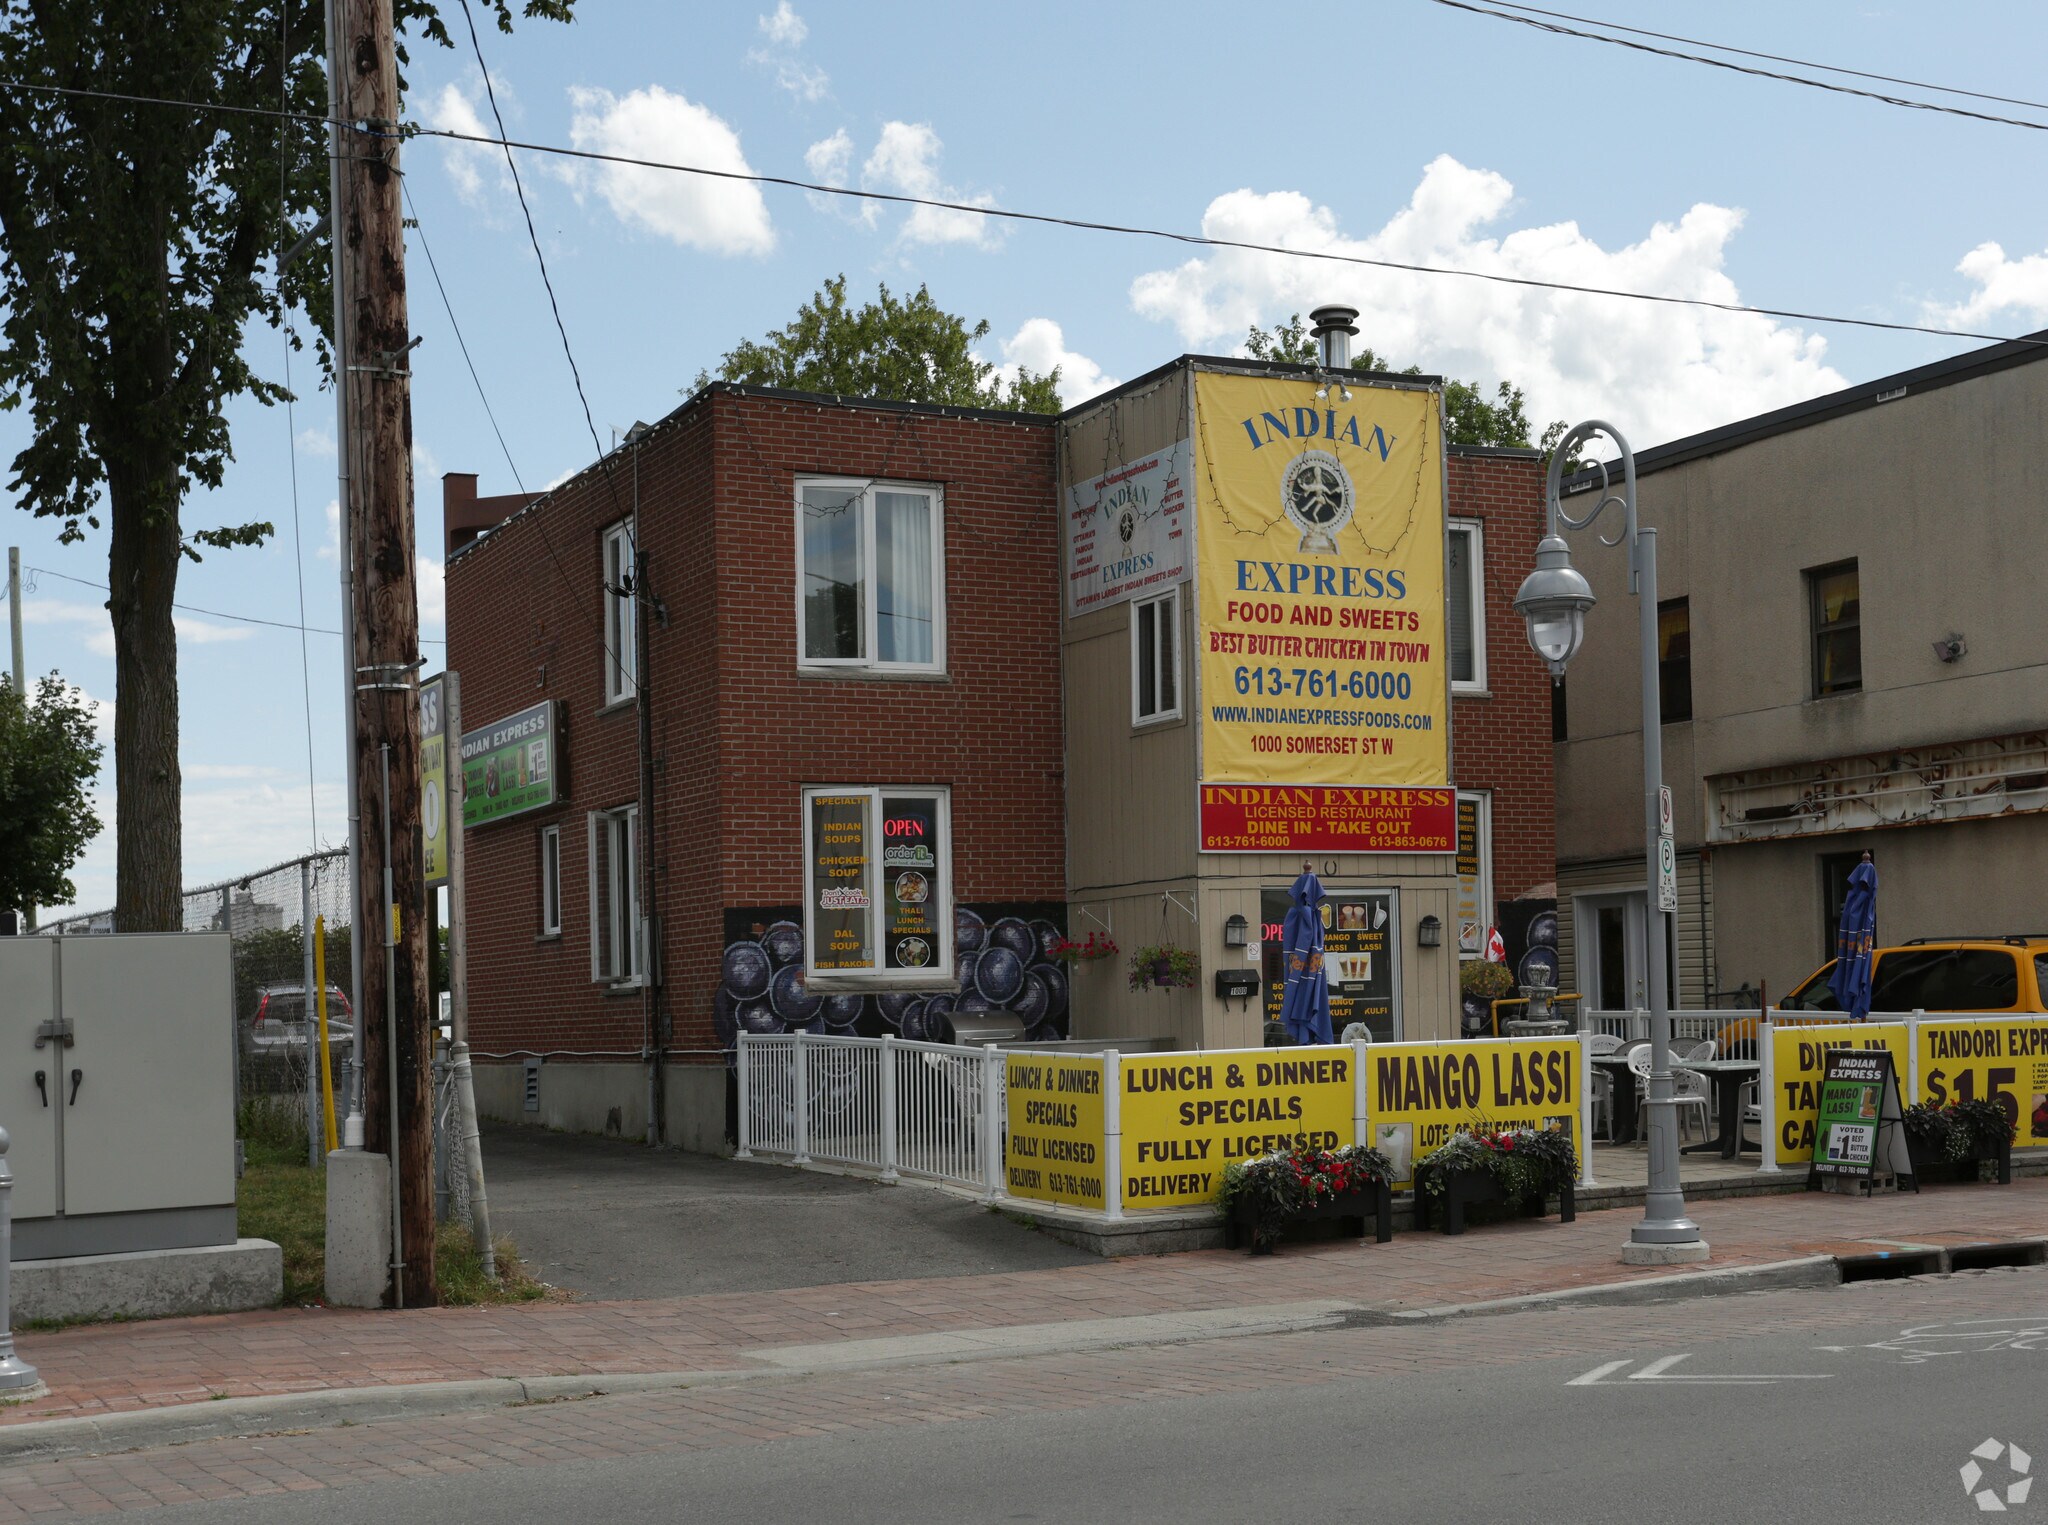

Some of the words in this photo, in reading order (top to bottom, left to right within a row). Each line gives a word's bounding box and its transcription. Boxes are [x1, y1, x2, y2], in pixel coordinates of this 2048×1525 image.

[1240, 407, 1397, 463] INDIAN
[1167, 478, 1180, 489] BEST
[1104, 485, 1150, 521] INDIAN
[1164, 490, 1184, 504] BUTTER
[1163, 502, 1185, 517] CHICKEN
[1171, 518, 1178, 527] IN
[1168, 529, 1183, 541] TOWN
[1075, 542, 1094, 555] FAMOUS
[1077, 555, 1093, 567] INDIAN
[1103, 551, 1154, 584] EXPRESS
[1070, 564, 1100, 581] RESTAURANT
[1234, 559, 1407, 600] EXPRESS
[1101, 584, 1124, 599] LARGEST
[1124, 578, 1143, 592] INDIAN
[1167, 565, 1183, 578] SHOP
[1227, 601, 1283, 624] FOOD
[1290, 605, 1333, 627] AND
[1339, 608, 1419, 632] SWEETS
[1210, 631, 1244, 653] BEST
[1248, 633, 1302, 657] BUTTER
[1305, 637, 1366, 661] CHICKEN
[1370, 640, 1386, 662] IN
[1389, 641, 1430, 663] TOWN
[1234, 666, 1411, 700] 613-761-6000
[1212, 706, 1432, 730] WWW.INDIANEXPRESSFOODS.COM
[494, 714, 545, 747] EXPRESS
[1250, 735, 1282, 753] 1000
[1286, 736, 1358, 754] SOMERSET
[1362, 738, 1378, 755] ST
[1382, 738, 1393, 755] W
[815, 798, 869, 806] SPECIALTY
[1204, 788, 1315, 805] INDIAN
[1323, 789, 1449, 807] EXPRESS
[1245, 806, 1316, 818] LICENSED
[1320, 807, 1412, 820] RESTAURANT
[824, 823, 861, 831] INDIAN
[884, 819, 924, 836] OPEN
[1247, 821, 1290, 834] DINE
[1294, 821, 1312, 834] IN
[1327, 822, 1371, 834] TAKE
[1376, 822, 1411, 834] OUT
[1458, 824, 1475, 832] SWEETS
[824, 835, 861, 843] SOUPS
[1207, 836, 1290, 846] 613-761-6000
[1369, 836, 1447, 847] 613-863-0676
[887, 847, 915, 859] order
[917, 847, 925, 859] it
[819, 856, 869, 865] CHICKEN
[829, 869, 859, 877] SOUP
[900, 907, 924, 915] THALI
[834, 930, 855, 938] DAL
[1260, 923, 1284, 941] OPE
[830, 942, 859, 950] SOUP
[1232, 987, 1247, 995] 1000
[1927, 1029, 2002, 1059] TANDORI
[1838, 1058, 1877, 1068] INDIAN
[1009, 1065, 1041, 1090] LUNCH
[1045, 1068, 1054, 1091] &
[1058, 1069, 1099, 1095] DINNER
[1127, 1066, 1213, 1093] LUNCH
[1225, 1063, 1244, 1088] &
[1256, 1059, 1347, 1087] DINNER
[1377, 1053, 1481, 1112] MANGO
[1492, 1050, 1571, 1107] LASSI
[1830, 1070, 1882, 1079] EXPRESS
[1826, 1088, 1858, 1100] MANGO
[1026, 1100, 1078, 1128] SPECIALS
[1179, 1095, 1302, 1126] SPECIALS
[1826, 1102, 1853, 1114] LASSI
[1420, 1123, 1449, 1147] LOTS
[1012, 1135, 1039, 1158] FULLY
[1043, 1138, 1095, 1164] LICENSED
[1138, 1138, 1212, 1163] FULLY
[1223, 1130, 1339, 1158] LICENSED
[1850, 1144, 1868, 1152] BUTTER
[1850, 1153, 1869, 1161] CHICKEN
[1815, 1163, 1835, 1172] DELIVERY
[1839, 1165, 1869, 1175] 613-761-6000
[1009, 1166, 1041, 1191] DELIVERY
[1049, 1171, 1101, 1199] 613-761-6000
[1128, 1172, 1212, 1198] DELIVERY
